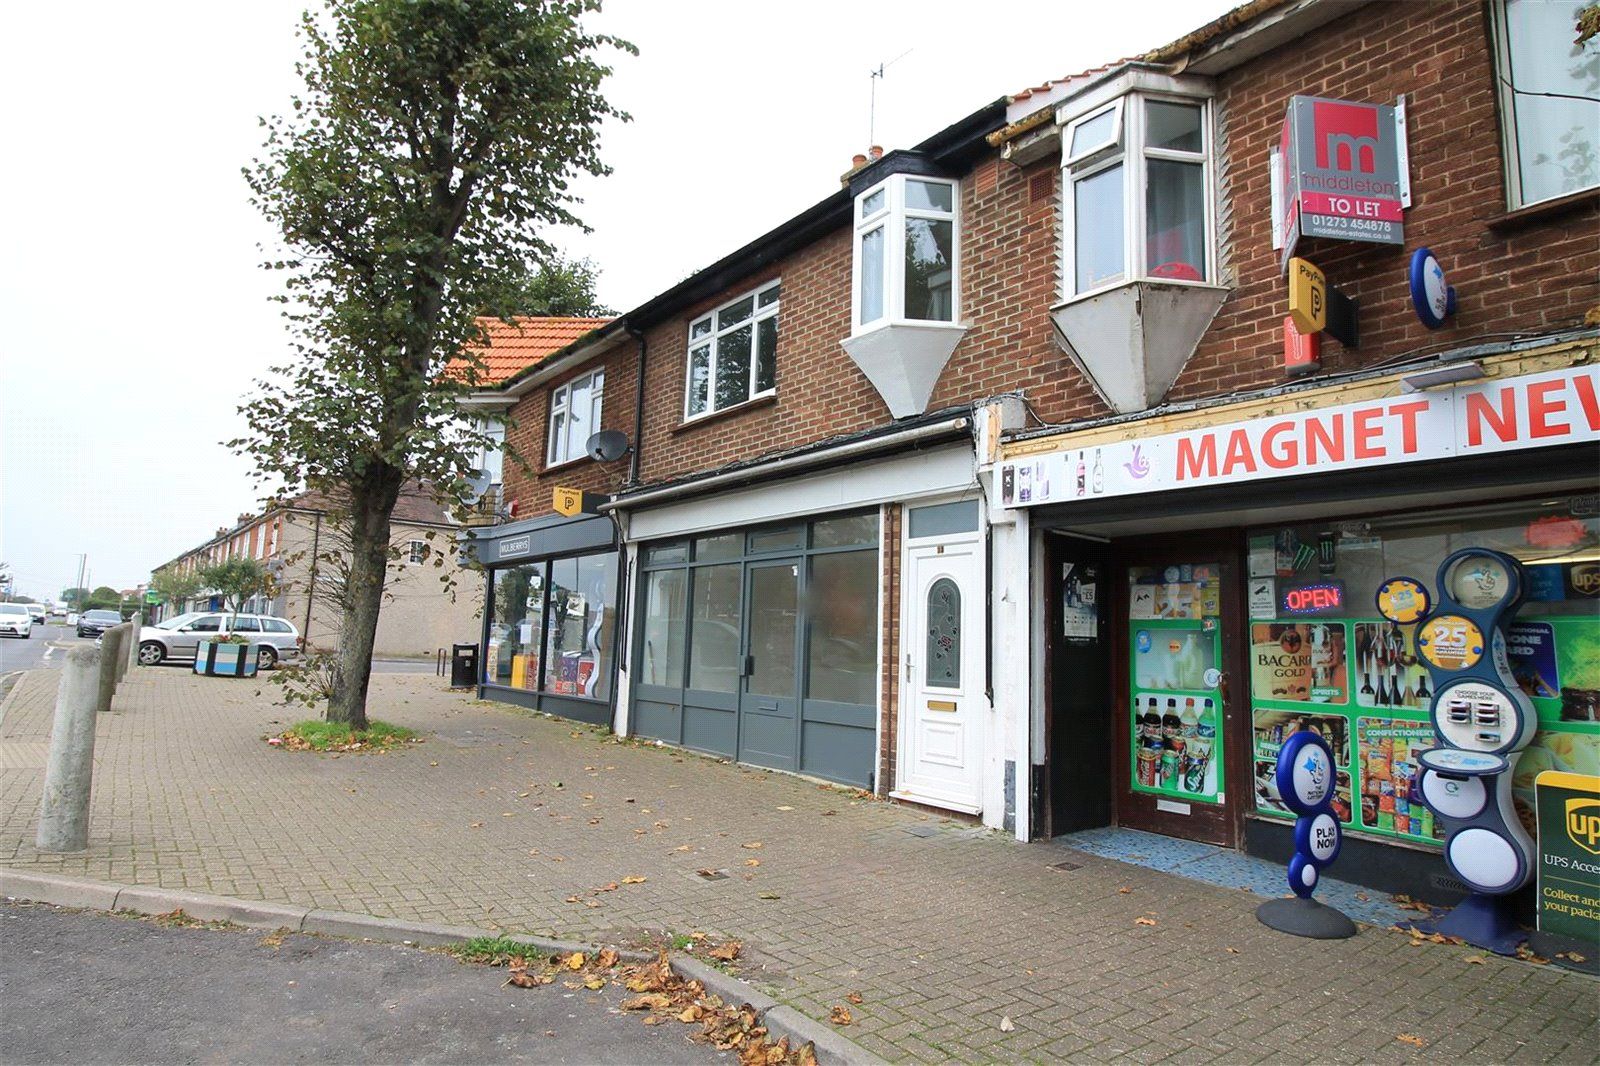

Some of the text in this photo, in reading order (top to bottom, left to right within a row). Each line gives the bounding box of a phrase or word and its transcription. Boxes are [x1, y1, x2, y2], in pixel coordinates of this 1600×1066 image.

[1304, 174, 1395, 195] middleton
[1328, 197, 1381, 217] TO LET
[1312, 214, 1348, 229] 01273
[1350, 219, 1392, 233] 454878
[1175, 400, 1431, 481] MAGNET
[1287, 589, 1339, 610] OPEN
[1434, 625, 1468, 648] 25
[1274, 668, 1306, 678] GOLD
[1311, 688, 1340, 697] SPIRITS
[1366, 728, 1435, 738] CONFECTIONERY
[1316, 826, 1336, 838] PLAY
[1570, 812, 1600, 845] up
[1316, 838, 1336, 849] NOW
[1543, 853, 1569, 868] UPS
[1543, 887, 1580, 903] Collect
[1544, 900, 1600, 921] your packa
